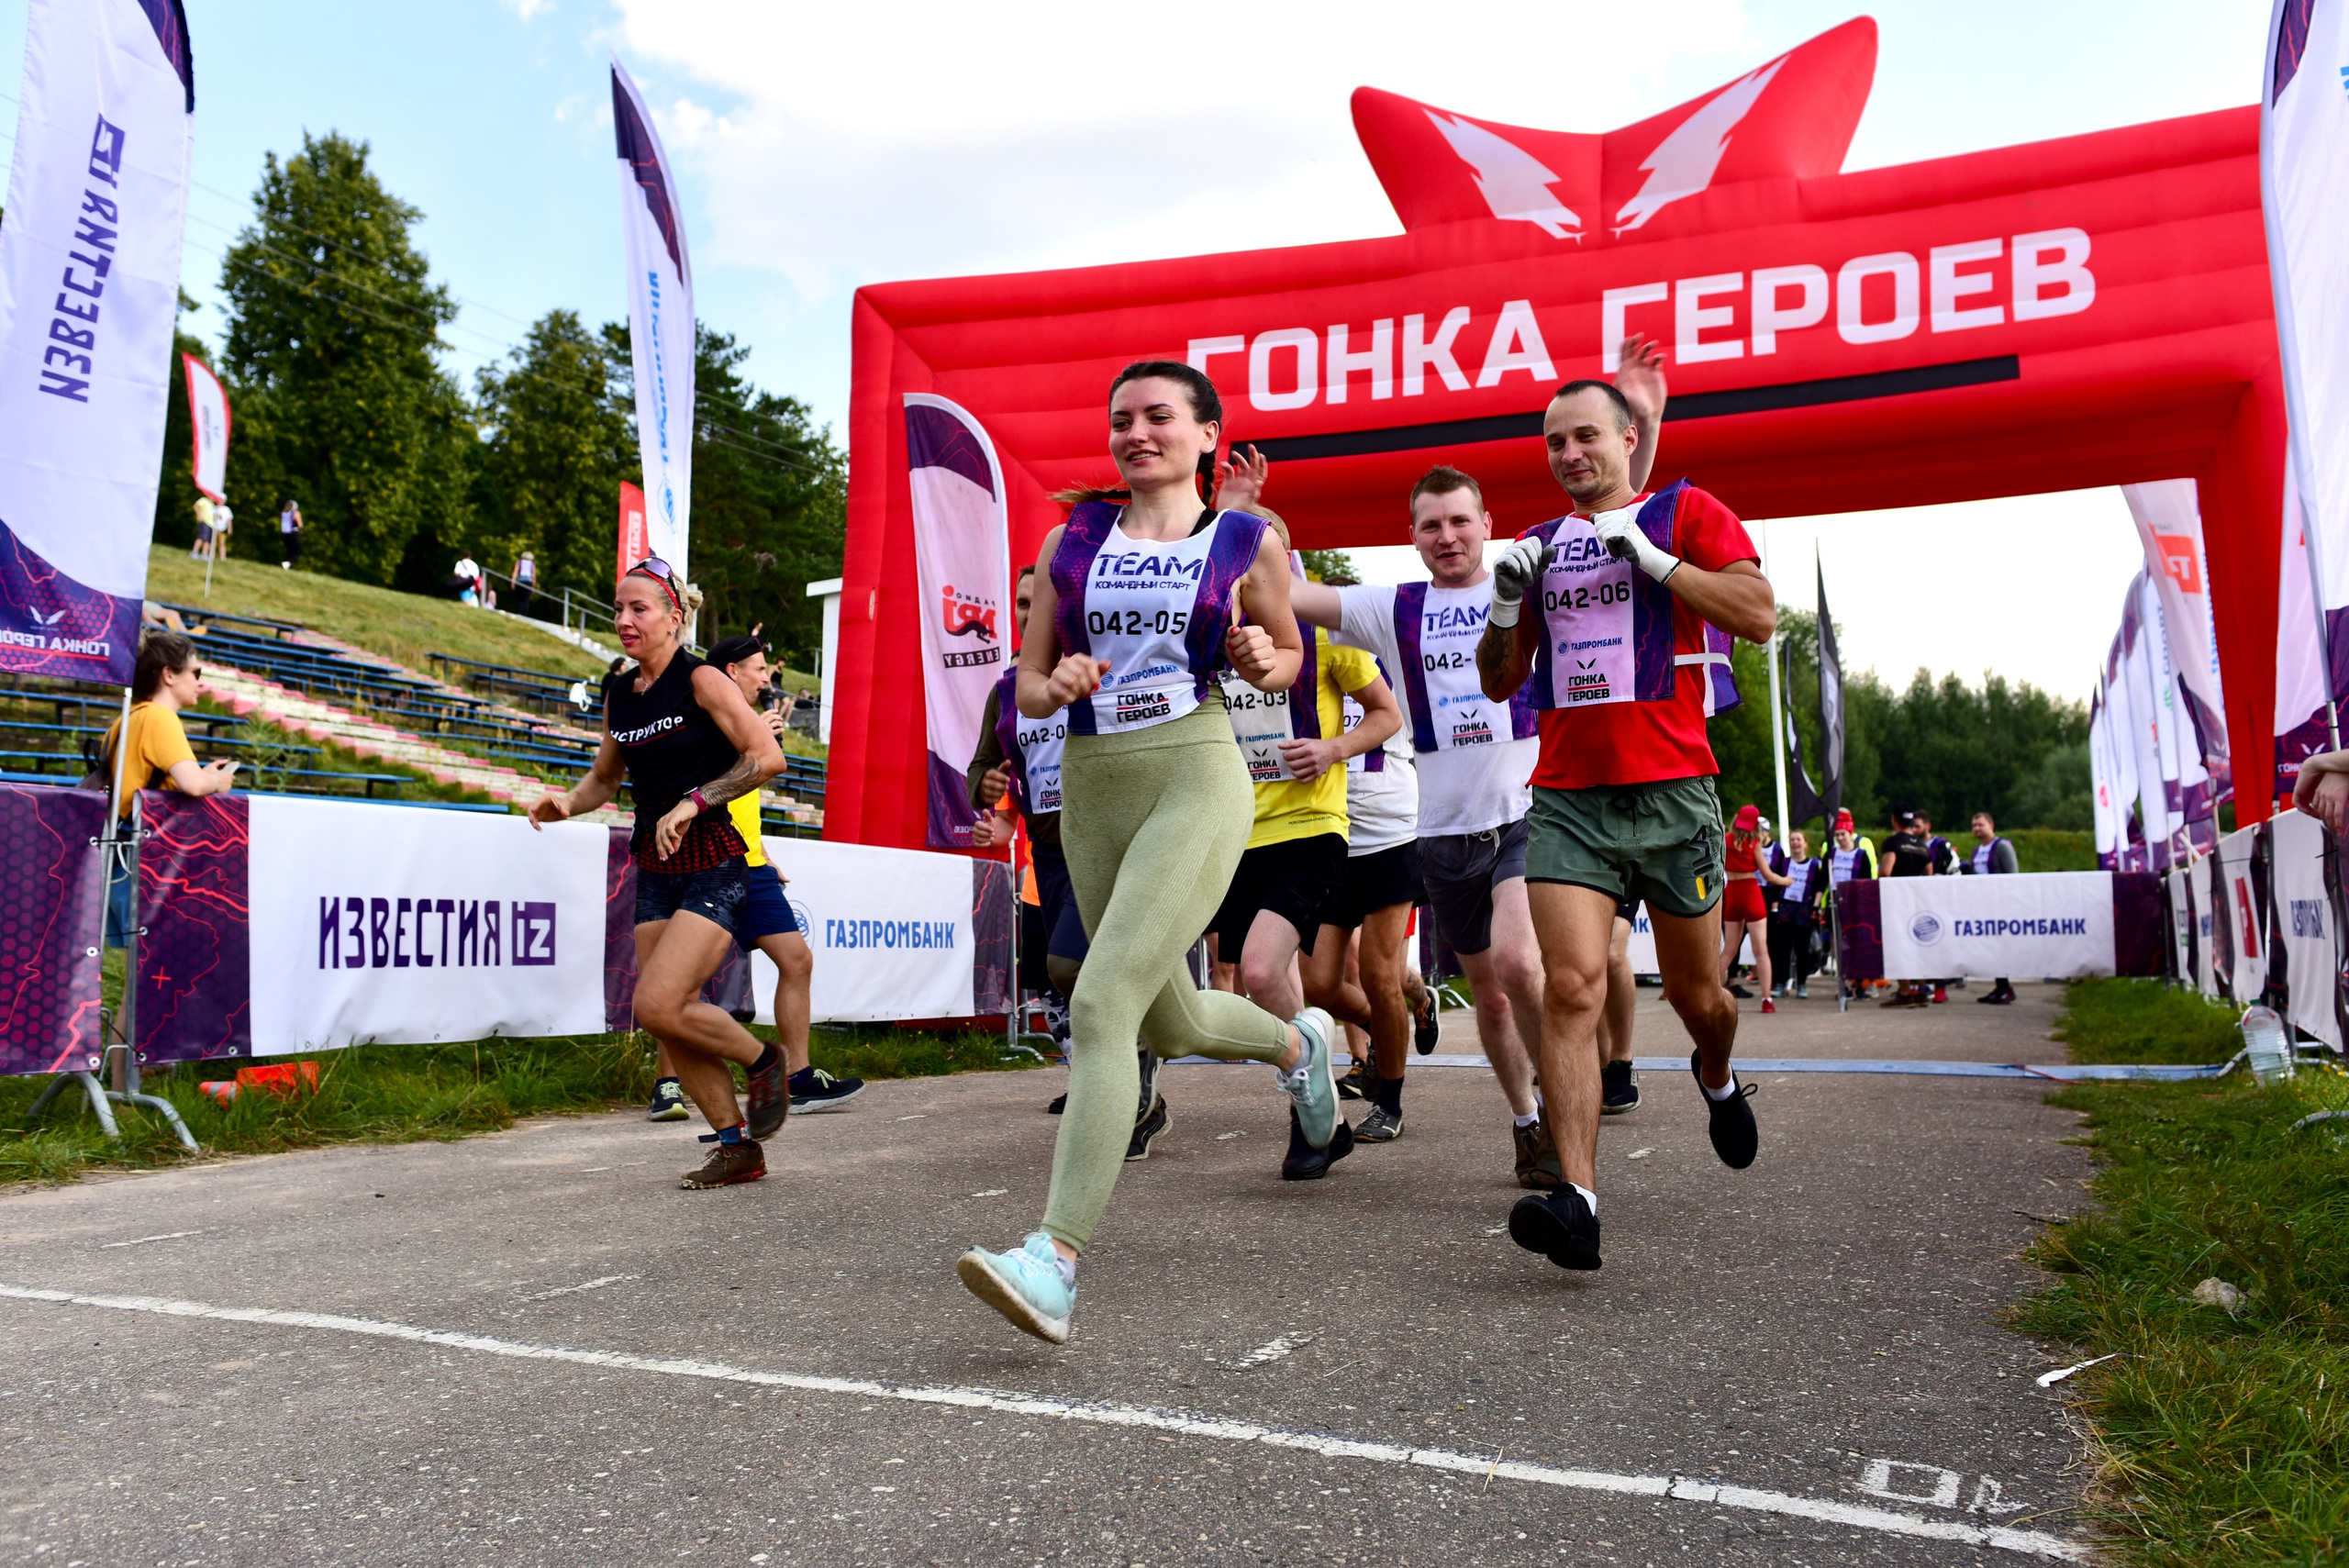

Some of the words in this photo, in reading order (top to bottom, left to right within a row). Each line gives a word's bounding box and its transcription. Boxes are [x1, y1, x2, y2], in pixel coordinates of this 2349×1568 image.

[1187, 298, 1559, 412] ГОНКА
[1602, 227, 2097, 374] ГЕРОЕВ
[1551, 537, 1609, 563] TEA
[1097, 552, 1205, 581] TEAM
[1550, 561, 1599, 574] КОМАНДНЫЙ
[1599, 555, 1625, 567] СТАРТ
[1095, 580, 1159, 590] КОМАНДНЫЙ
[1159, 581, 1191, 591] СТАРТ
[1544, 581, 1631, 611] 042-06
[1088, 610, 1187, 635] 042-05
[1471, 628, 1486, 637] СТА
[1571, 637, 1623, 651] ГАЗПРОМБАНК
[1117, 664, 1180, 685] ГАЗПРОМБАНК
[1568, 673, 1607, 687] ГОНКА
[1117, 693, 1166, 706] ГОНКА
[1224, 690, 1286, 711] 042-03
[1567, 688, 1610, 703] ГЕРОЕВ
[1116, 703, 1172, 723] ГЕРОЕВ
[1019, 724, 1066, 748] 042-0
[1453, 720, 1489, 735] ГОНКА
[1245, 732, 1286, 743] ГАЗПРОМБАНК
[1453, 733, 1494, 747] ГЕРОЕВ
[1247, 759, 1278, 770] ГОНКА
[1251, 771, 1282, 782] ЕРОЕВ
[1040, 790, 1061, 799] ГОНК
[1040, 801, 1062, 810] ГЕРО
[318, 895, 501, 970] ИЗВЕСТИЯ
[826, 918, 955, 950] ГАЗПРОМБАНК
[1954, 918, 2087, 937] ГАЗПРОМБАНК
